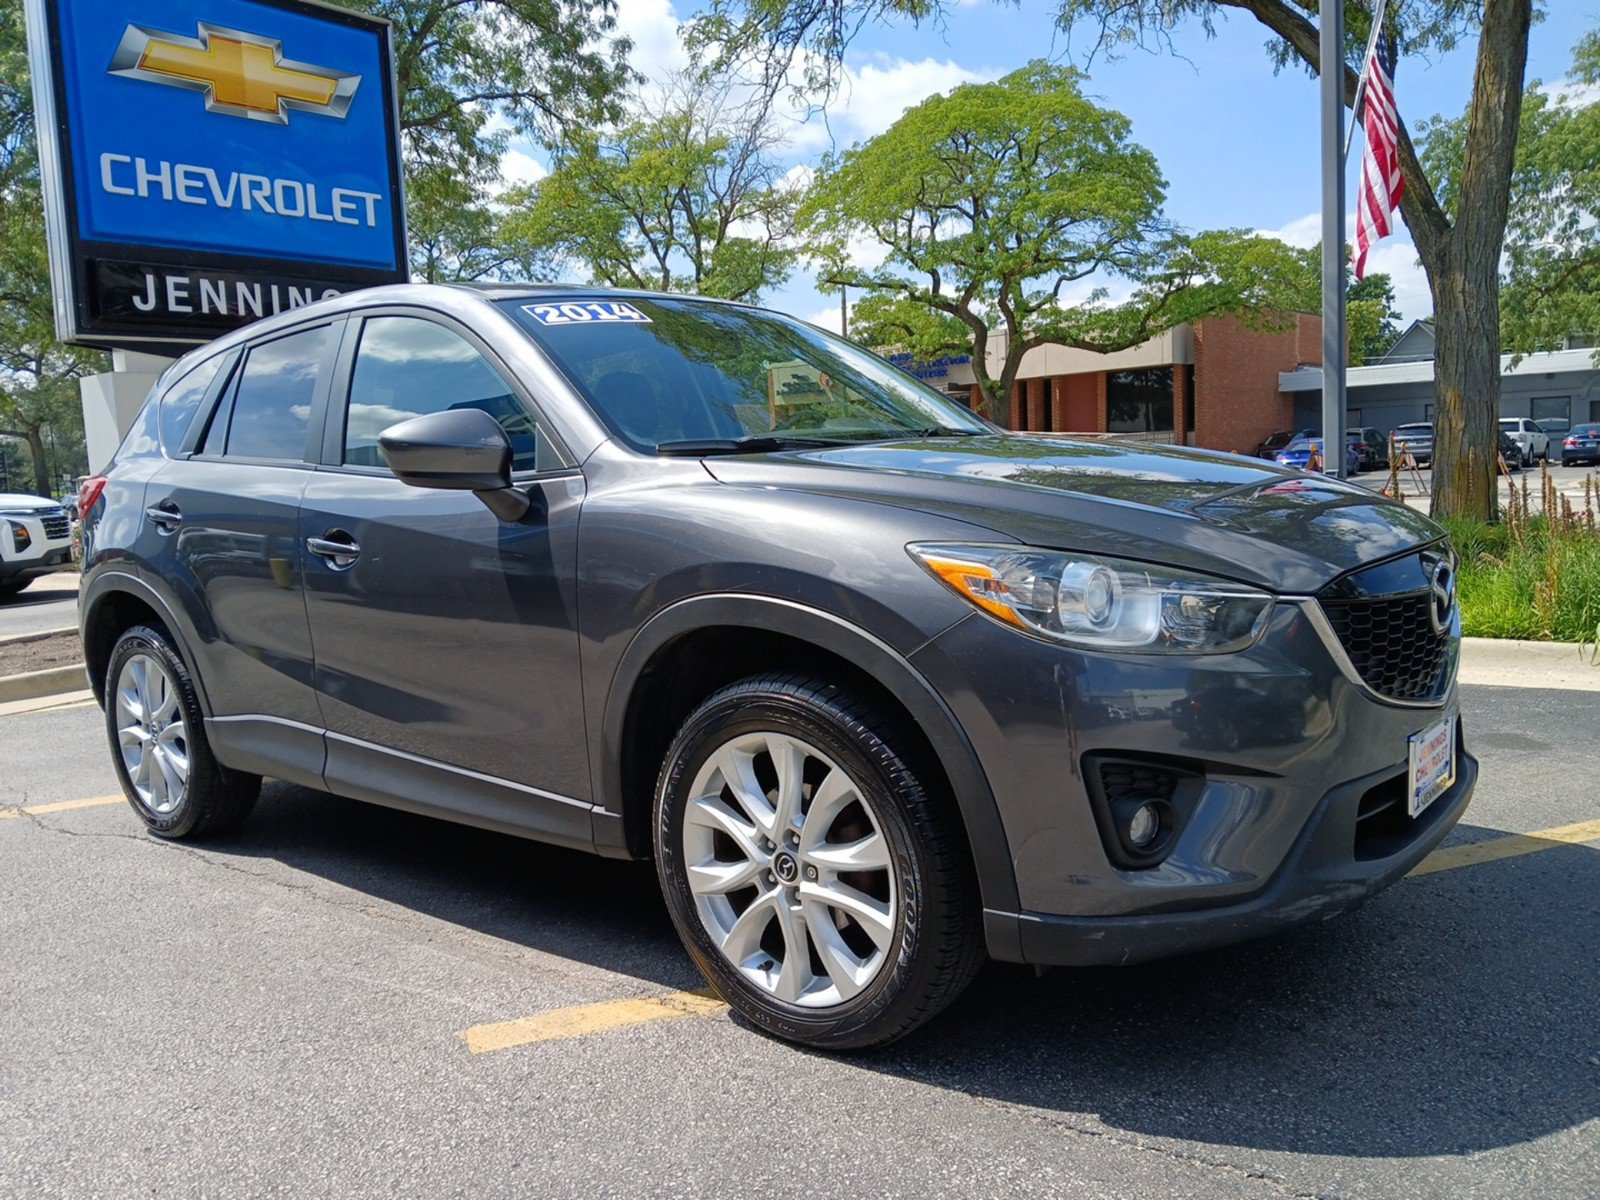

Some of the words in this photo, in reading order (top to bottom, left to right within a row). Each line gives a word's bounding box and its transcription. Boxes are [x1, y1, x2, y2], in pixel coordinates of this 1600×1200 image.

[100, 153, 382, 227] CHEVROLET
[132, 273, 341, 318] JENNIN
[534, 302, 642, 323] 2014
[1415, 744, 1449, 783] CHEVROLET
